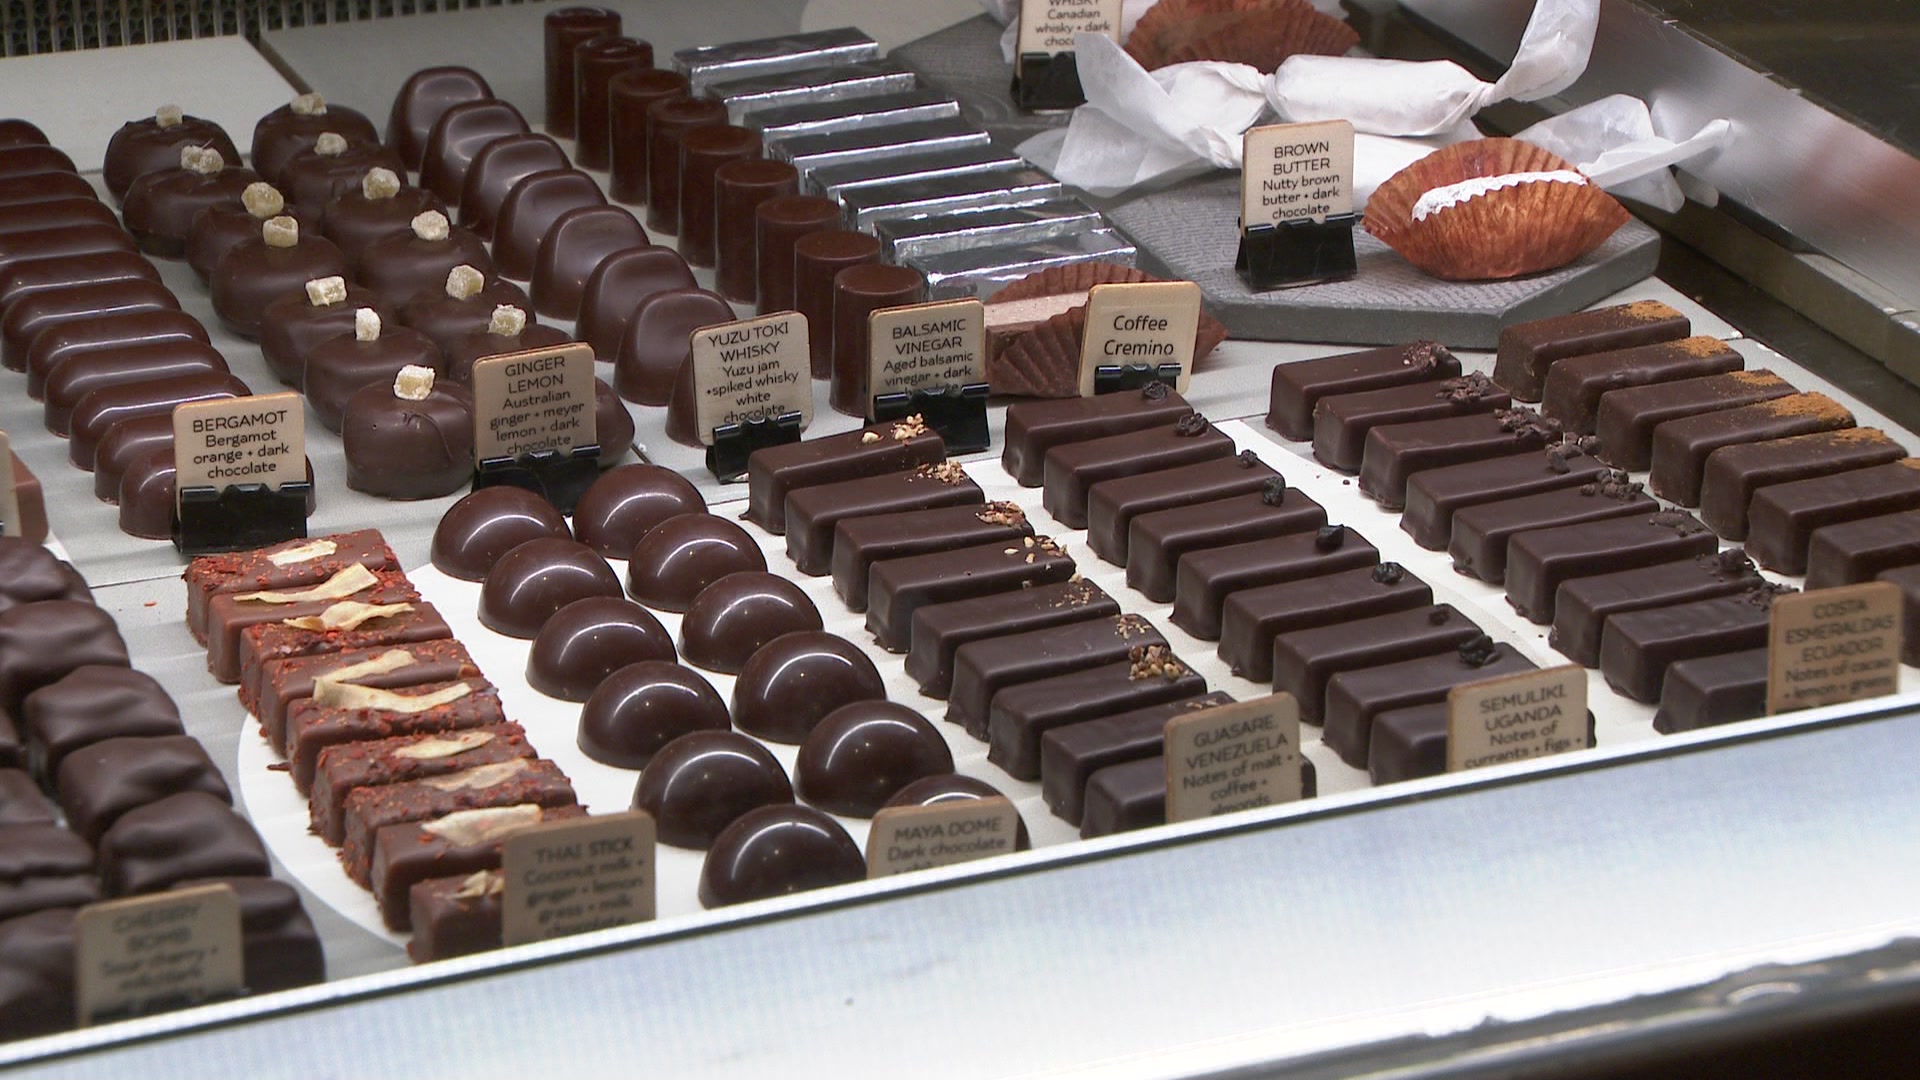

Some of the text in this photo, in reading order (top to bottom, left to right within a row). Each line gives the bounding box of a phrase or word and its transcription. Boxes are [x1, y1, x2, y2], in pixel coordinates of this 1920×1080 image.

[1047, 8, 1100, 20] Canadian
[1035, 21, 1110, 34] whisky dark
[1274, 141, 1330, 159] BROWN
[1273, 158, 1331, 176] BUTTER
[1263, 174, 1340, 192] Nutty brown
[1262, 186, 1340, 206] butter dark
[1272, 204, 1330, 220] chocolate
[892, 318, 967, 340] BALSAMIC
[1113, 315, 1168, 331] Coffee
[708, 321, 790, 348] YUZU TOKI
[720, 341, 780, 363] WHISKY
[895, 336, 963, 355] VINEGAR
[1103, 339, 1174, 355] Cremino
[505, 355, 566, 377] GINGER
[722, 360, 780, 378] Yuzu jam
[883, 351, 974, 374] Aged balsamic
[508, 373, 564, 394] LEMON
[712, 370, 799, 397] spiked whisky
[884, 365, 972, 387] vinegar dark
[502, 390, 571, 411] Australian
[736, 392, 771, 407] white
[193, 409, 288, 433] BERGAMOT
[489, 402, 585, 431] ginger meyer
[723, 403, 786, 424] chocolate
[206, 429, 277, 448] Bergamot
[496, 417, 580, 442] lemon dark
[193, 442, 290, 465] orange dark
[506, 434, 572, 455] chocolate
[207, 461, 277, 479] chocolate
[1802, 638, 1883, 662] ECUADOR
[1485, 704, 1562, 732] UGANDA
[1489, 720, 1559, 746] Notes of
[1186, 733, 1289, 769] VENEZUELA
[1183, 754, 1283, 790] Notes of malt
[1210, 780, 1257, 801] coffee
[894, 816, 1003, 842] MAYA DOME
[536, 836, 632, 864] THAI STICK
[888, 836, 1007, 861] Dark chocolate
